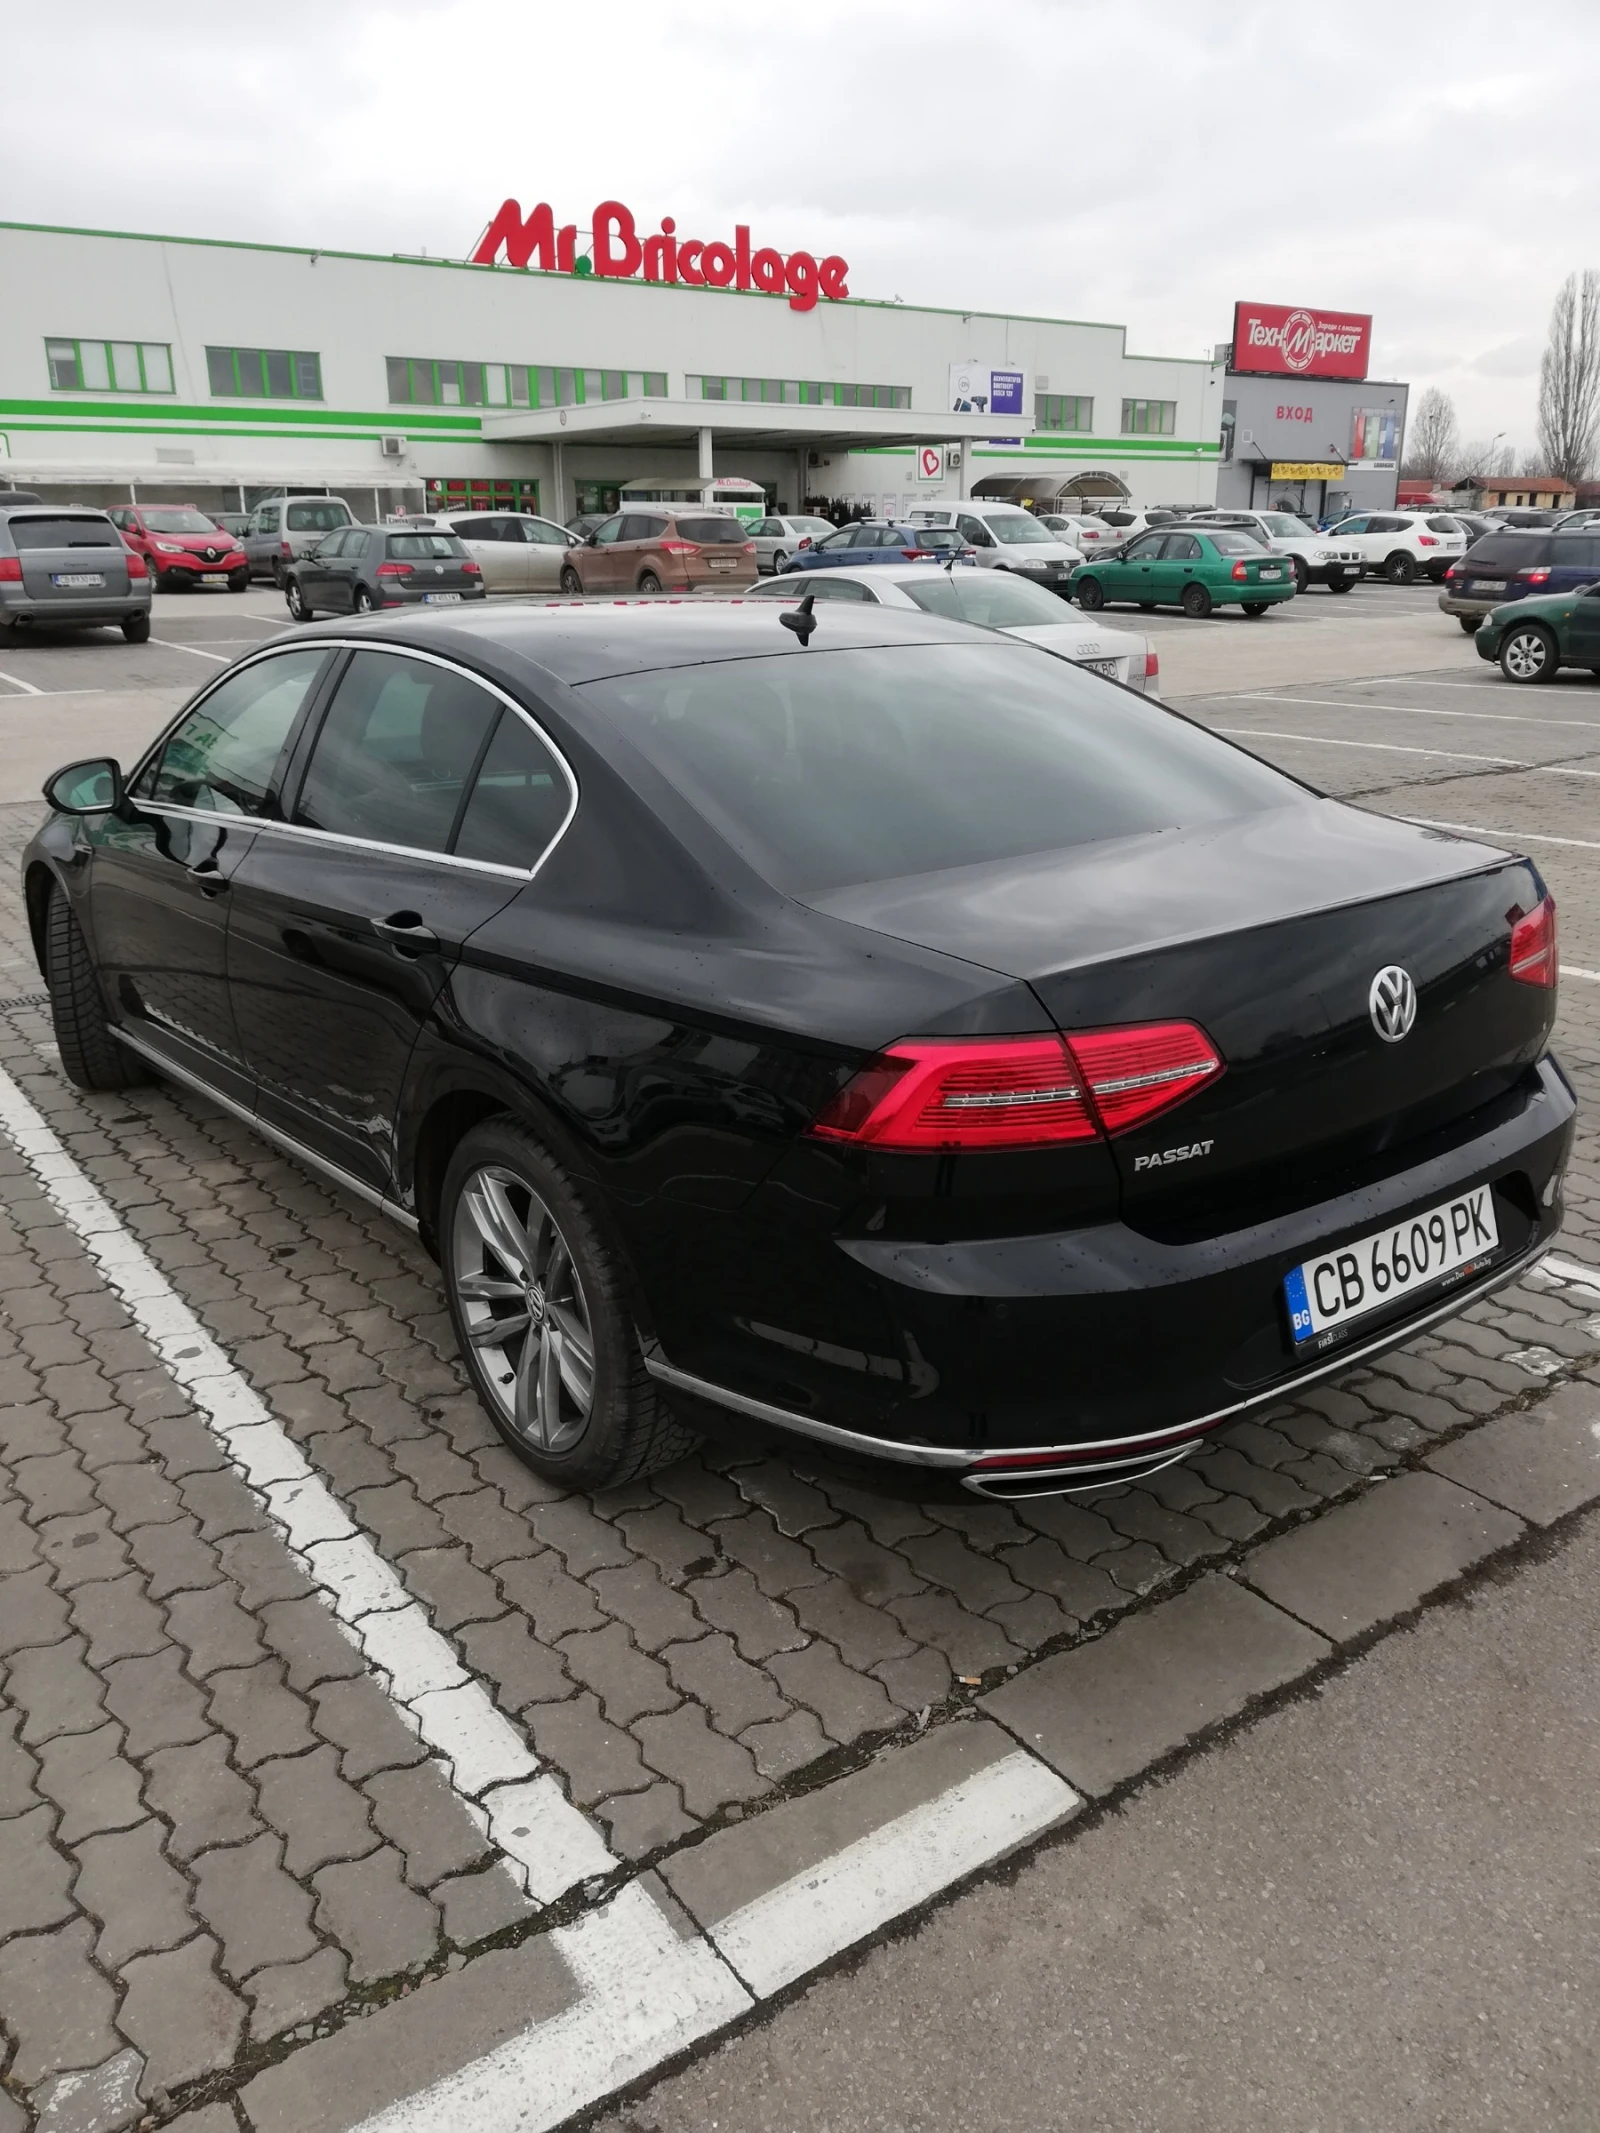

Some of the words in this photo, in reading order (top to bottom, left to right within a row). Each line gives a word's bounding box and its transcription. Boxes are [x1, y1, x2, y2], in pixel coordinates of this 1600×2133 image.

[1276, 405, 1313, 423] ВХОД
[1134, 1139, 1215, 1172] PASSAT
[1313, 1252, 1365, 1318] CB
[1371, 1214, 1447, 1293] 6609
[1450, 1191, 1492, 1256] PK
[1292, 1308, 1311, 1331] BG
